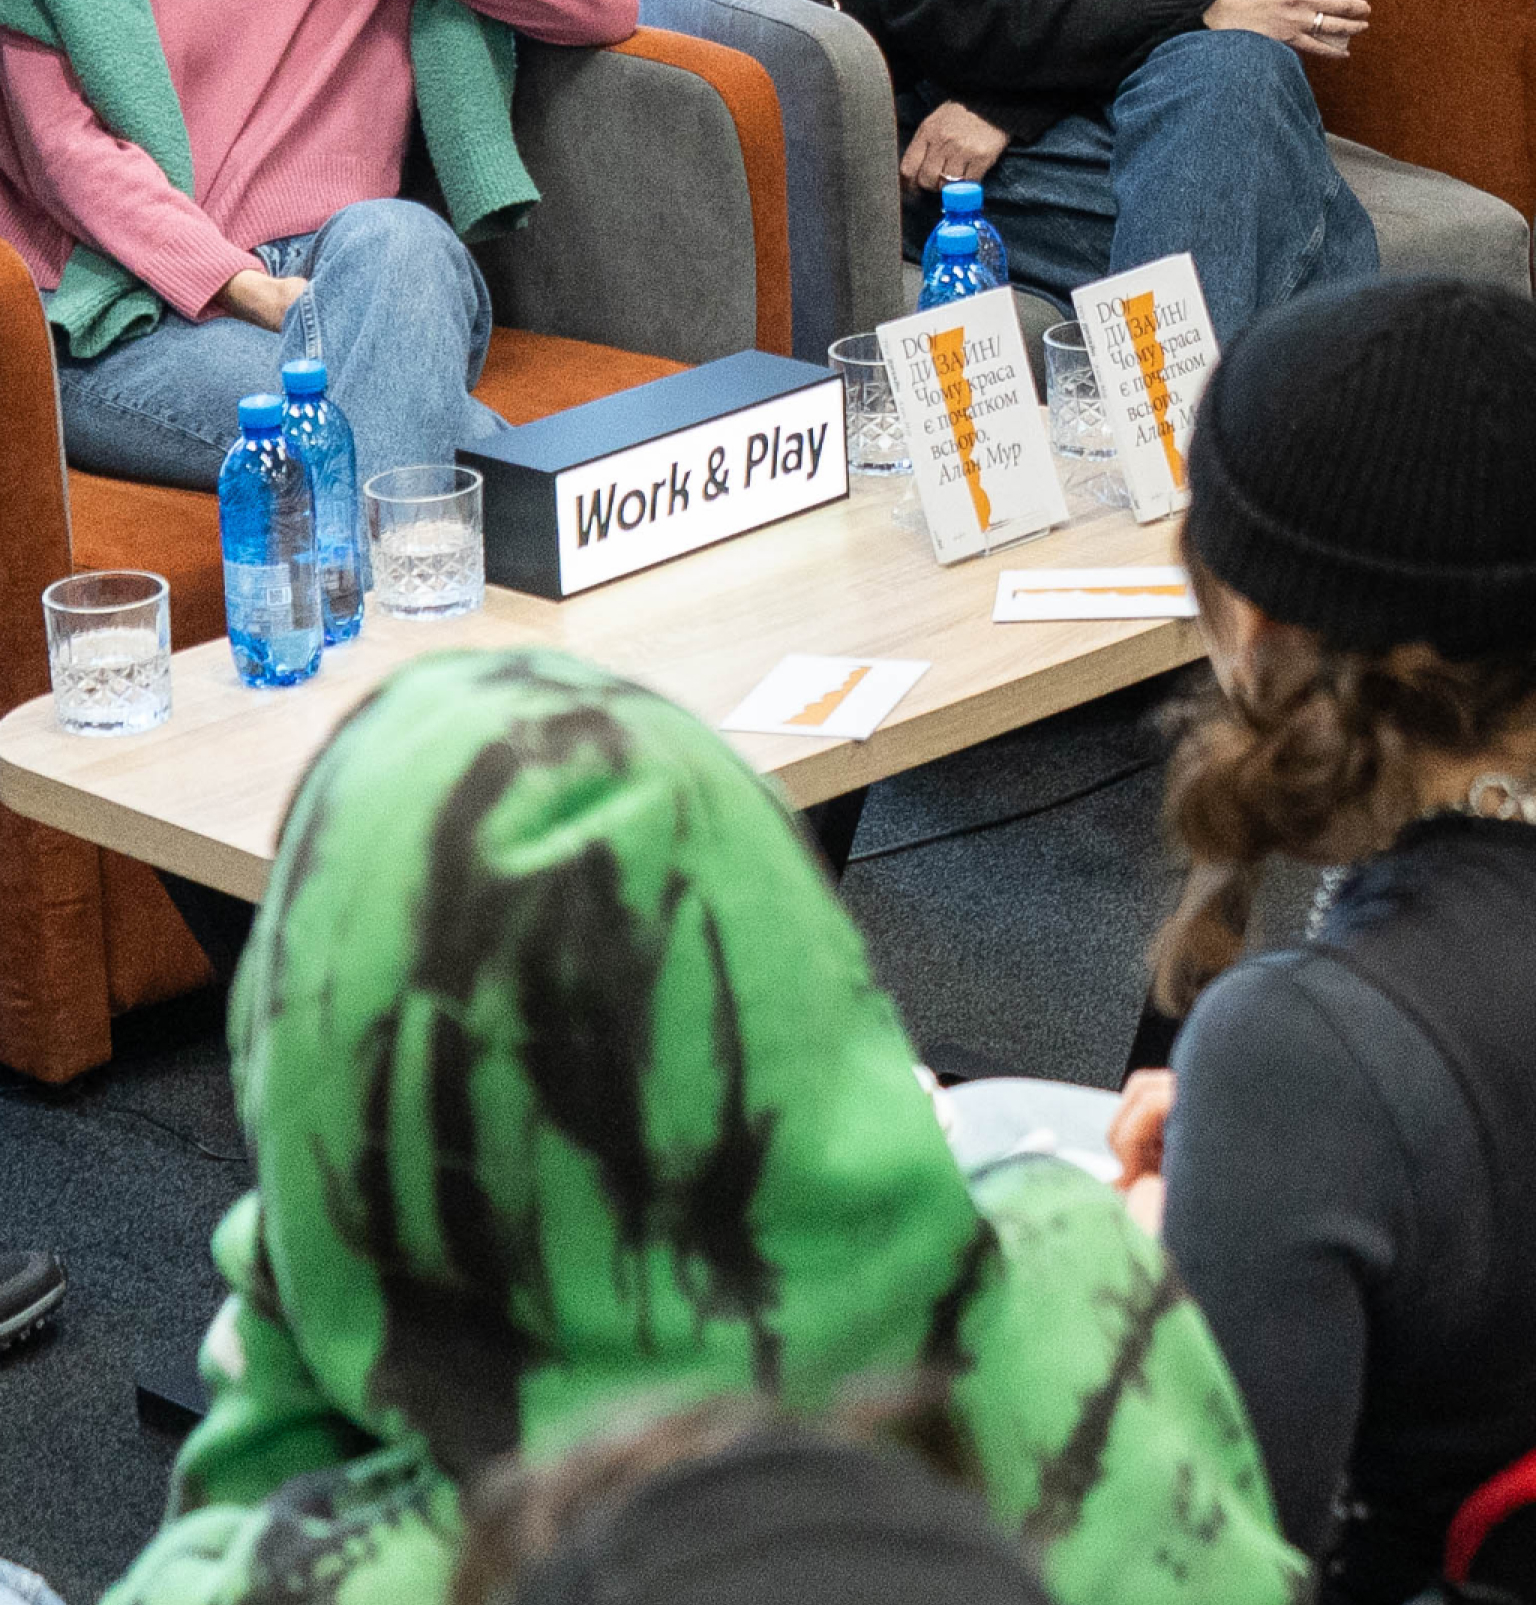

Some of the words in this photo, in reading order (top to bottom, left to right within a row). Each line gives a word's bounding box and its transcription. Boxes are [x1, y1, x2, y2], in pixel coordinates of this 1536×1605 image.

[1096, 292, 1131, 324] DO/
[1104, 297, 1188, 350] ДИЗАЙН/
[901, 328, 937, 360] DO/
[908, 335, 1001, 387] ДИЗАЙН/
[1110, 342, 1156, 373] Чому
[1159, 328, 1202, 361] краса
[915, 379, 964, 409] Чому
[968, 364, 1016, 398] краса
[1119, 382, 1129, 397] є
[1133, 353, 1206, 392] початком
[923, 419, 935, 435] є
[938, 391, 1019, 429] початком
[1126, 391, 1183, 423] всього.
[930, 429, 991, 461] всього.
[1135, 420, 1176, 447] Алан
[576, 469, 693, 548] Work
[703, 448, 730, 502] &
[743, 420, 830, 491] Play
[938, 460, 983, 486] Алан
[986, 442, 1023, 473] Мур
